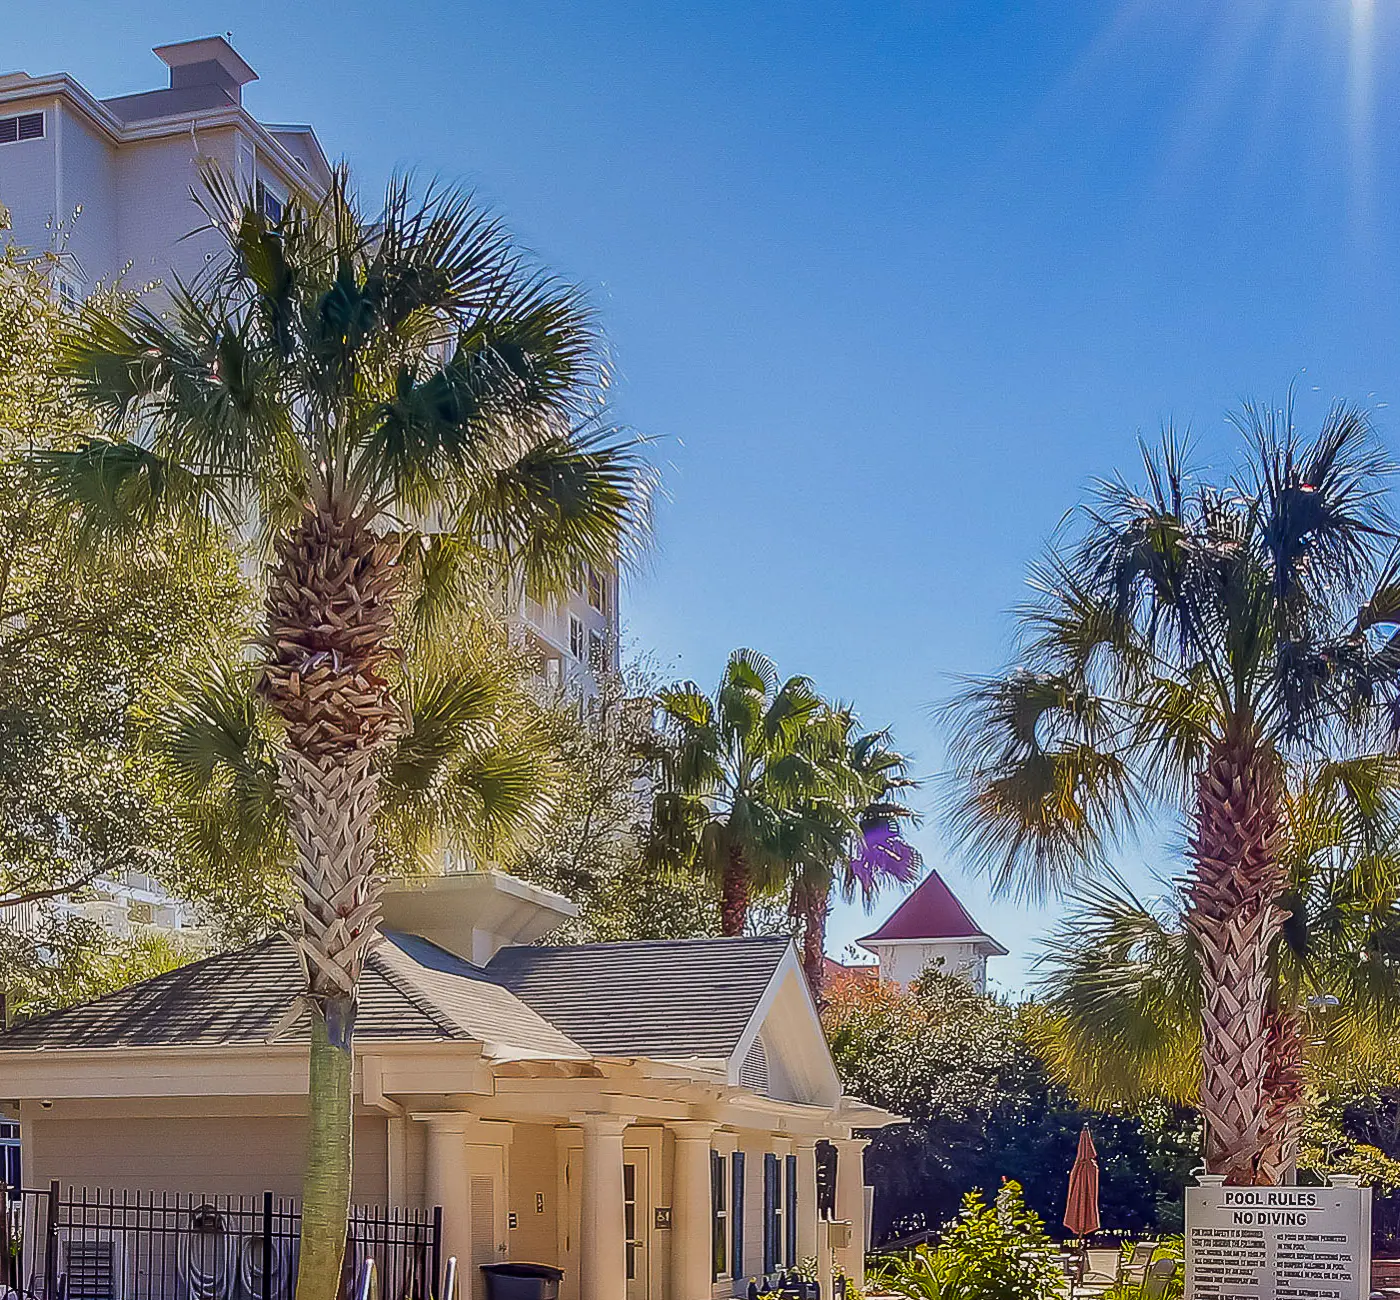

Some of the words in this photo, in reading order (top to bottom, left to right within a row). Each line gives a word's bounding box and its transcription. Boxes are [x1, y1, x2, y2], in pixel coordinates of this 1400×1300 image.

[1225, 1192, 1264, 1206] POOL
[1267, 1193, 1317, 1207] RULES
[1233, 1212, 1254, 1225] NO
[1257, 1212, 1308, 1226] DIVING
